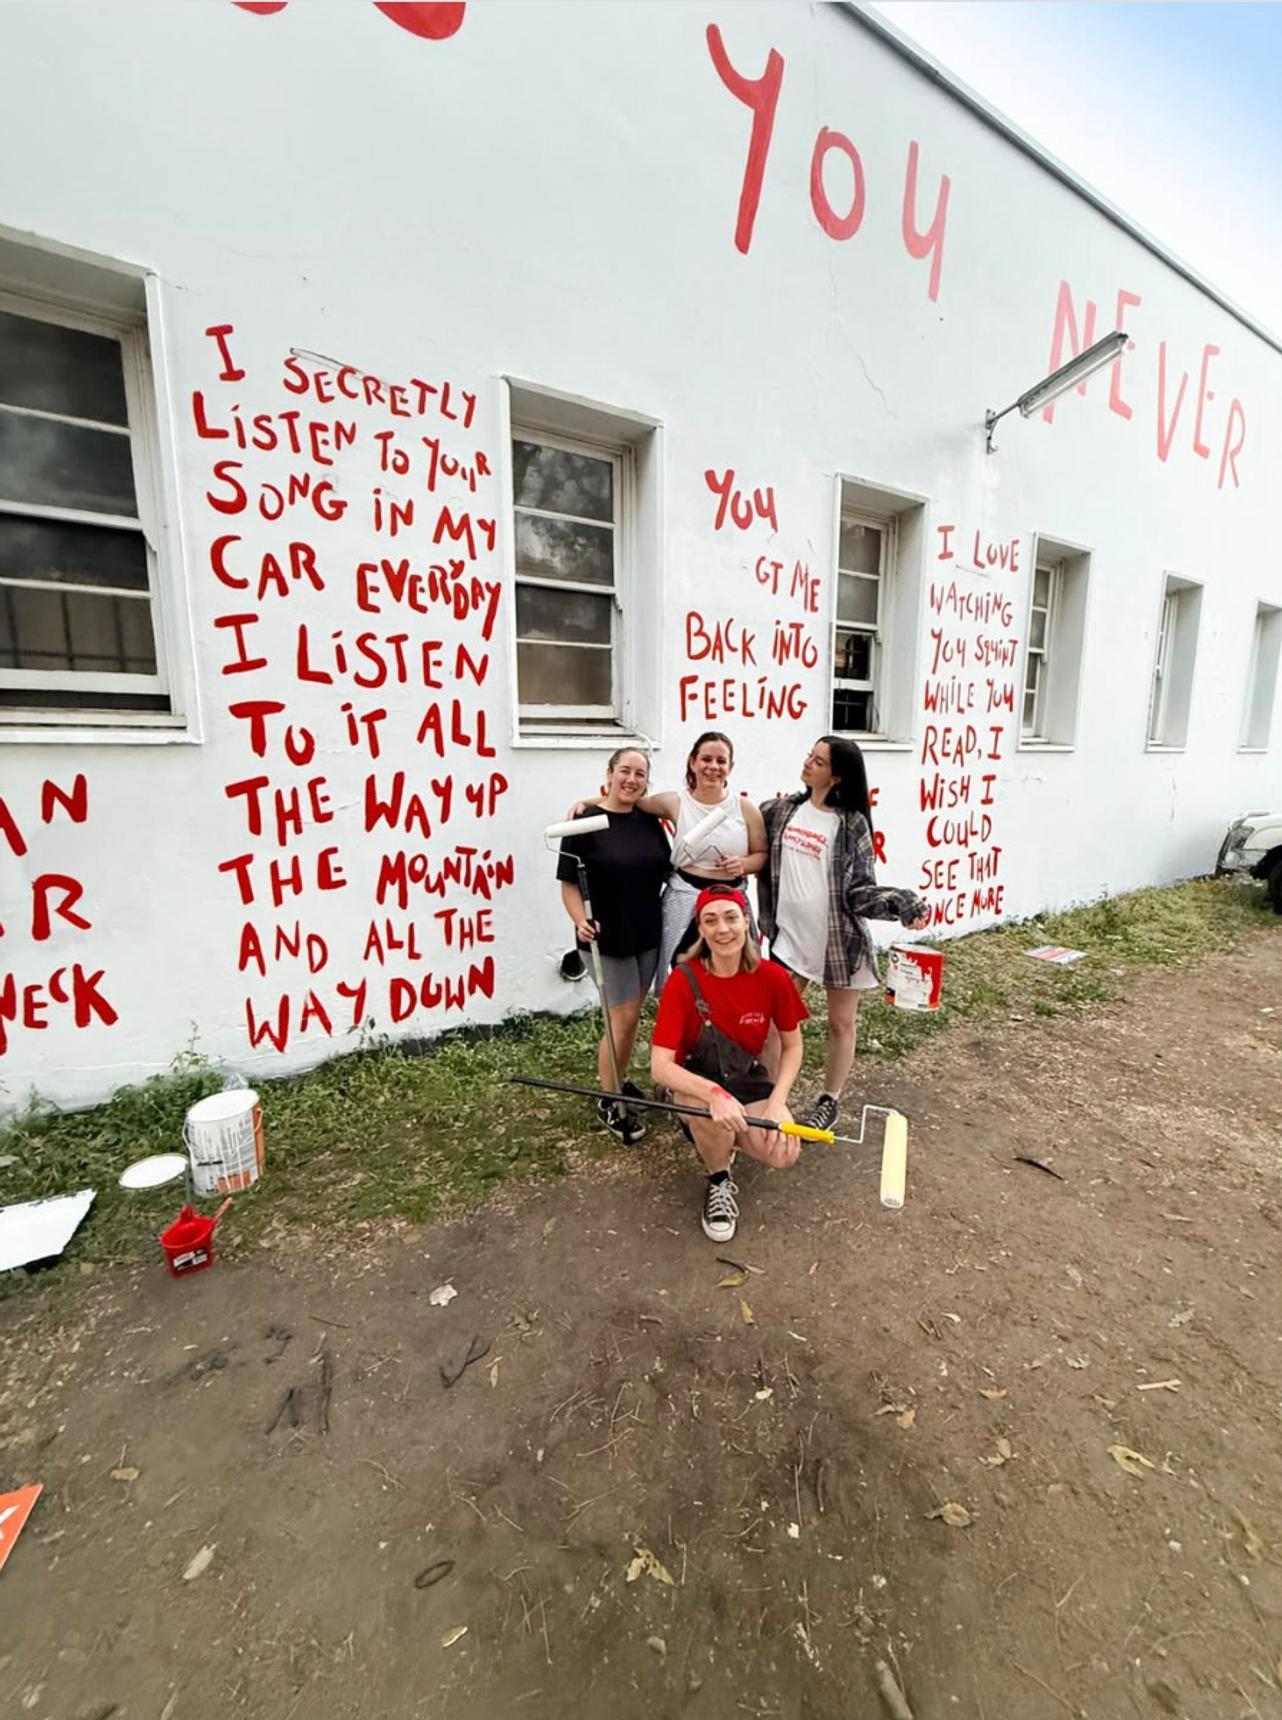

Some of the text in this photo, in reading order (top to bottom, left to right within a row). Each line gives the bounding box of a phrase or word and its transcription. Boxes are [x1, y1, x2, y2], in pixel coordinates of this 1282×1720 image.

[706, 23, 1246, 489] YOU NEVER
[205, 325, 476, 428] I SECRETLY
[374, 431, 410, 475] TO
[422, 436, 491, 492] YOUR
[207, 461, 348, 521] SONG
[433, 506, 495, 560] MY
[704, 469, 778, 533] YOU
[937, 525, 1020, 572] I LOVE
[210, 535, 501, 640] CAR EVERYDAY
[790, 560, 821, 613] ME
[214, 613, 268, 675] I
[686, 611, 757, 666] BACK
[931, 628, 966, 675] YOU
[986, 678, 1014, 713] YOU
[228, 700, 316, 766] TO
[416, 699, 496, 758] ALL
[921, 725, 1004, 767] READ, I
[225, 771, 509, 847] THE WAY UP
[980, 774, 997, 805] I
[927, 811, 992, 848] COULD
[218, 847, 347, 906] THE
[919, 846, 1002, 890] SEE THAT
[971, 885, 1004, 917] MORE
[238, 908, 495, 976] AND ALL THE
[246, 956, 495, 1053] WAY DOWN
